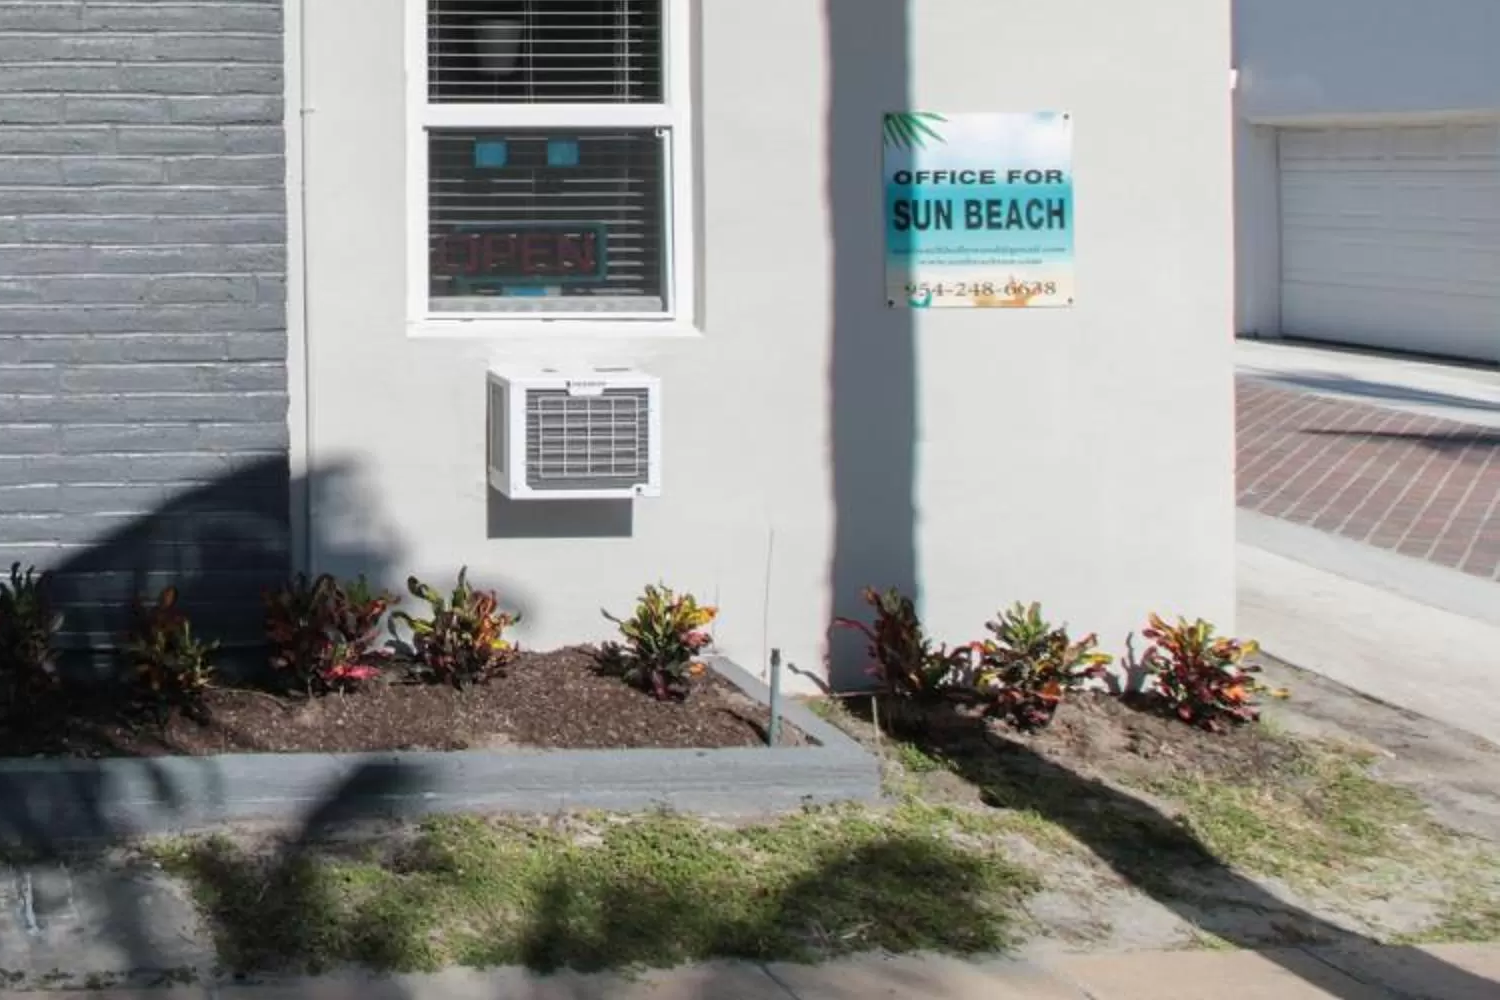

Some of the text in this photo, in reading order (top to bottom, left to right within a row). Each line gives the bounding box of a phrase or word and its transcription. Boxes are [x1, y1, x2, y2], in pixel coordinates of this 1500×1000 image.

[892, 169, 1064, 185] OFFICE FOR
[893, 198, 1066, 231] SUN BEACH
